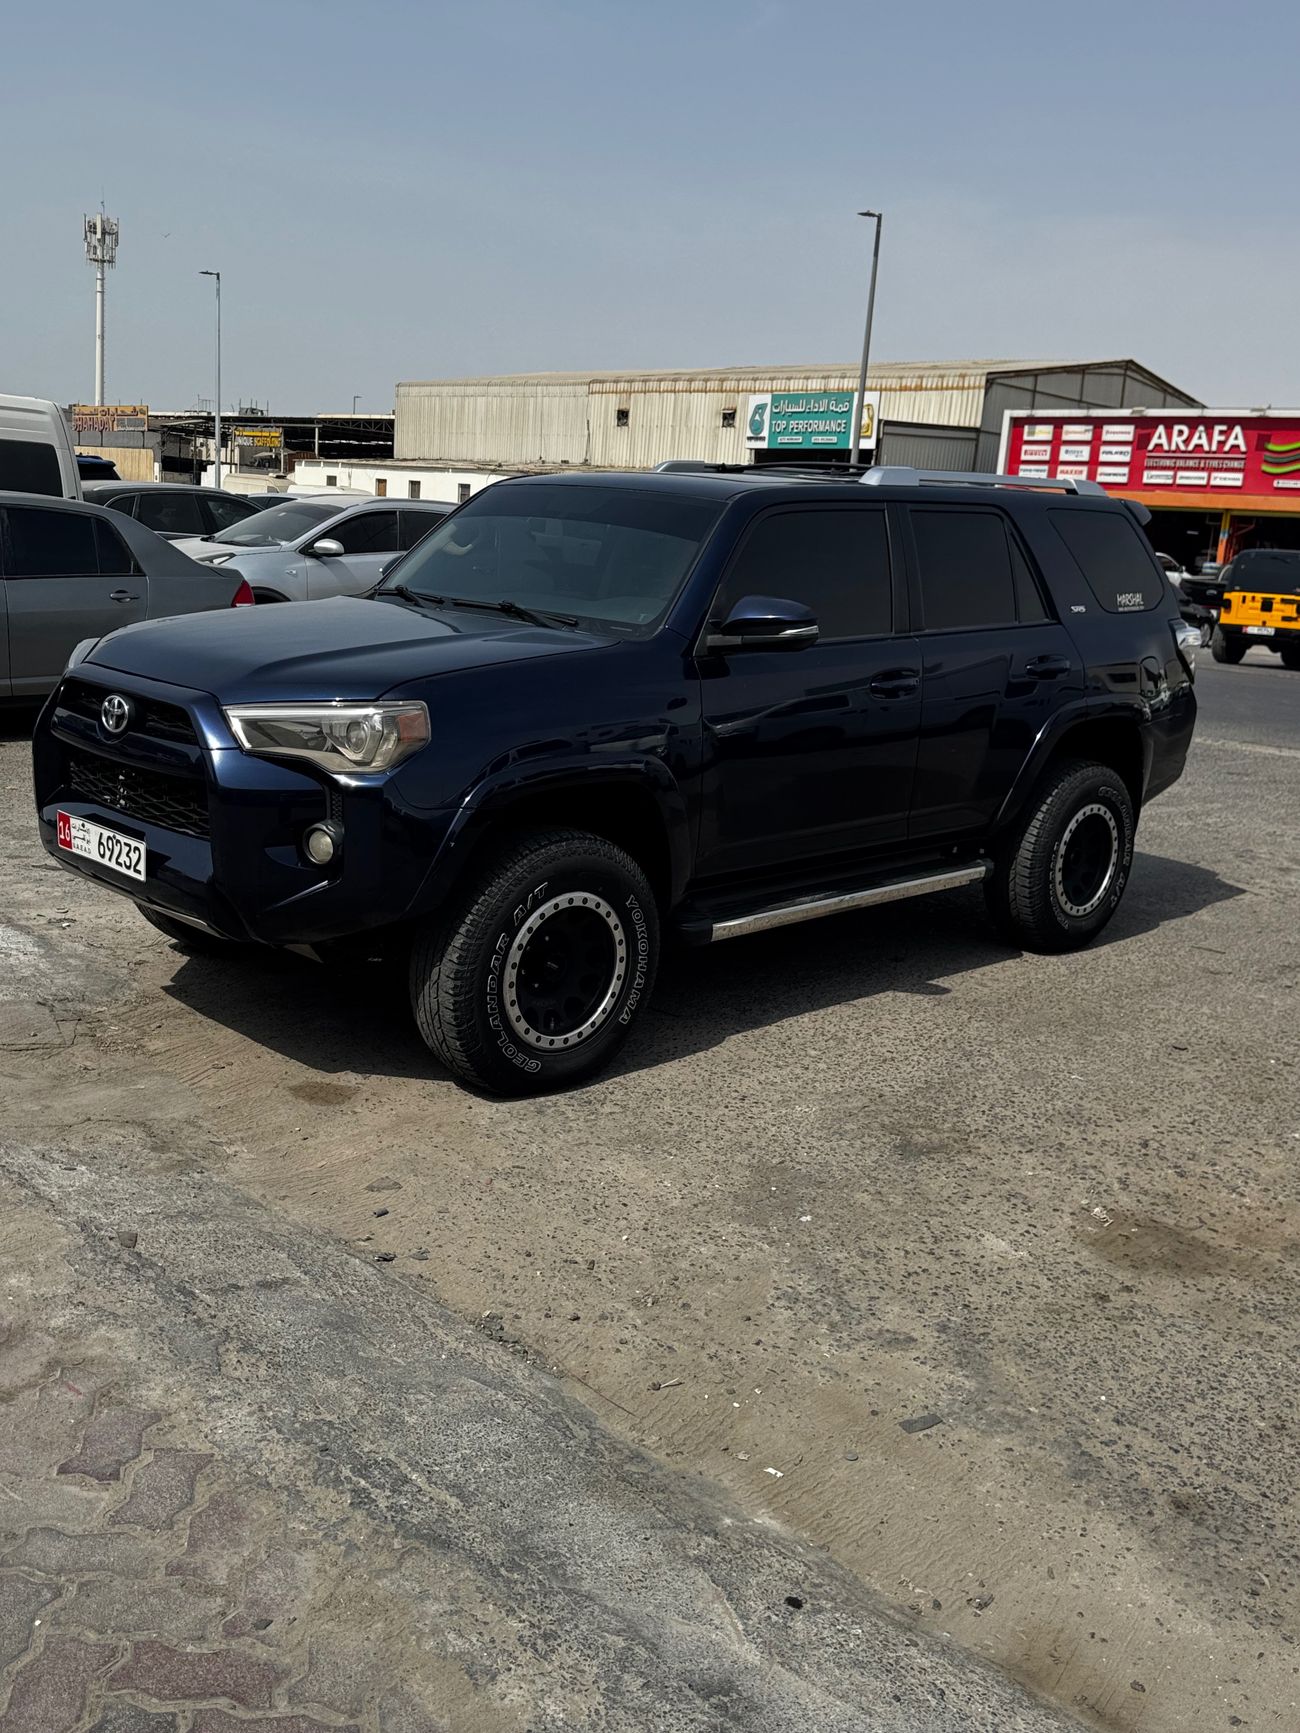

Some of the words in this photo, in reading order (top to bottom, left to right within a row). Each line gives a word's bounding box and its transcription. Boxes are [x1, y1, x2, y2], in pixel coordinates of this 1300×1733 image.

[830, 397, 850, 413] قمة
[771, 420, 786, 433] TOP
[789, 420, 846, 433] PERFORMANCE
[1146, 424, 1247, 452] ARAFA
[59, 820, 71, 842] 16
[97, 831, 142, 876] 69232
[513, 881, 548, 926] A/T
[618, 893, 648, 1025] YOKOHAMA
[487, 932, 542, 1073] GEOLANDAR
